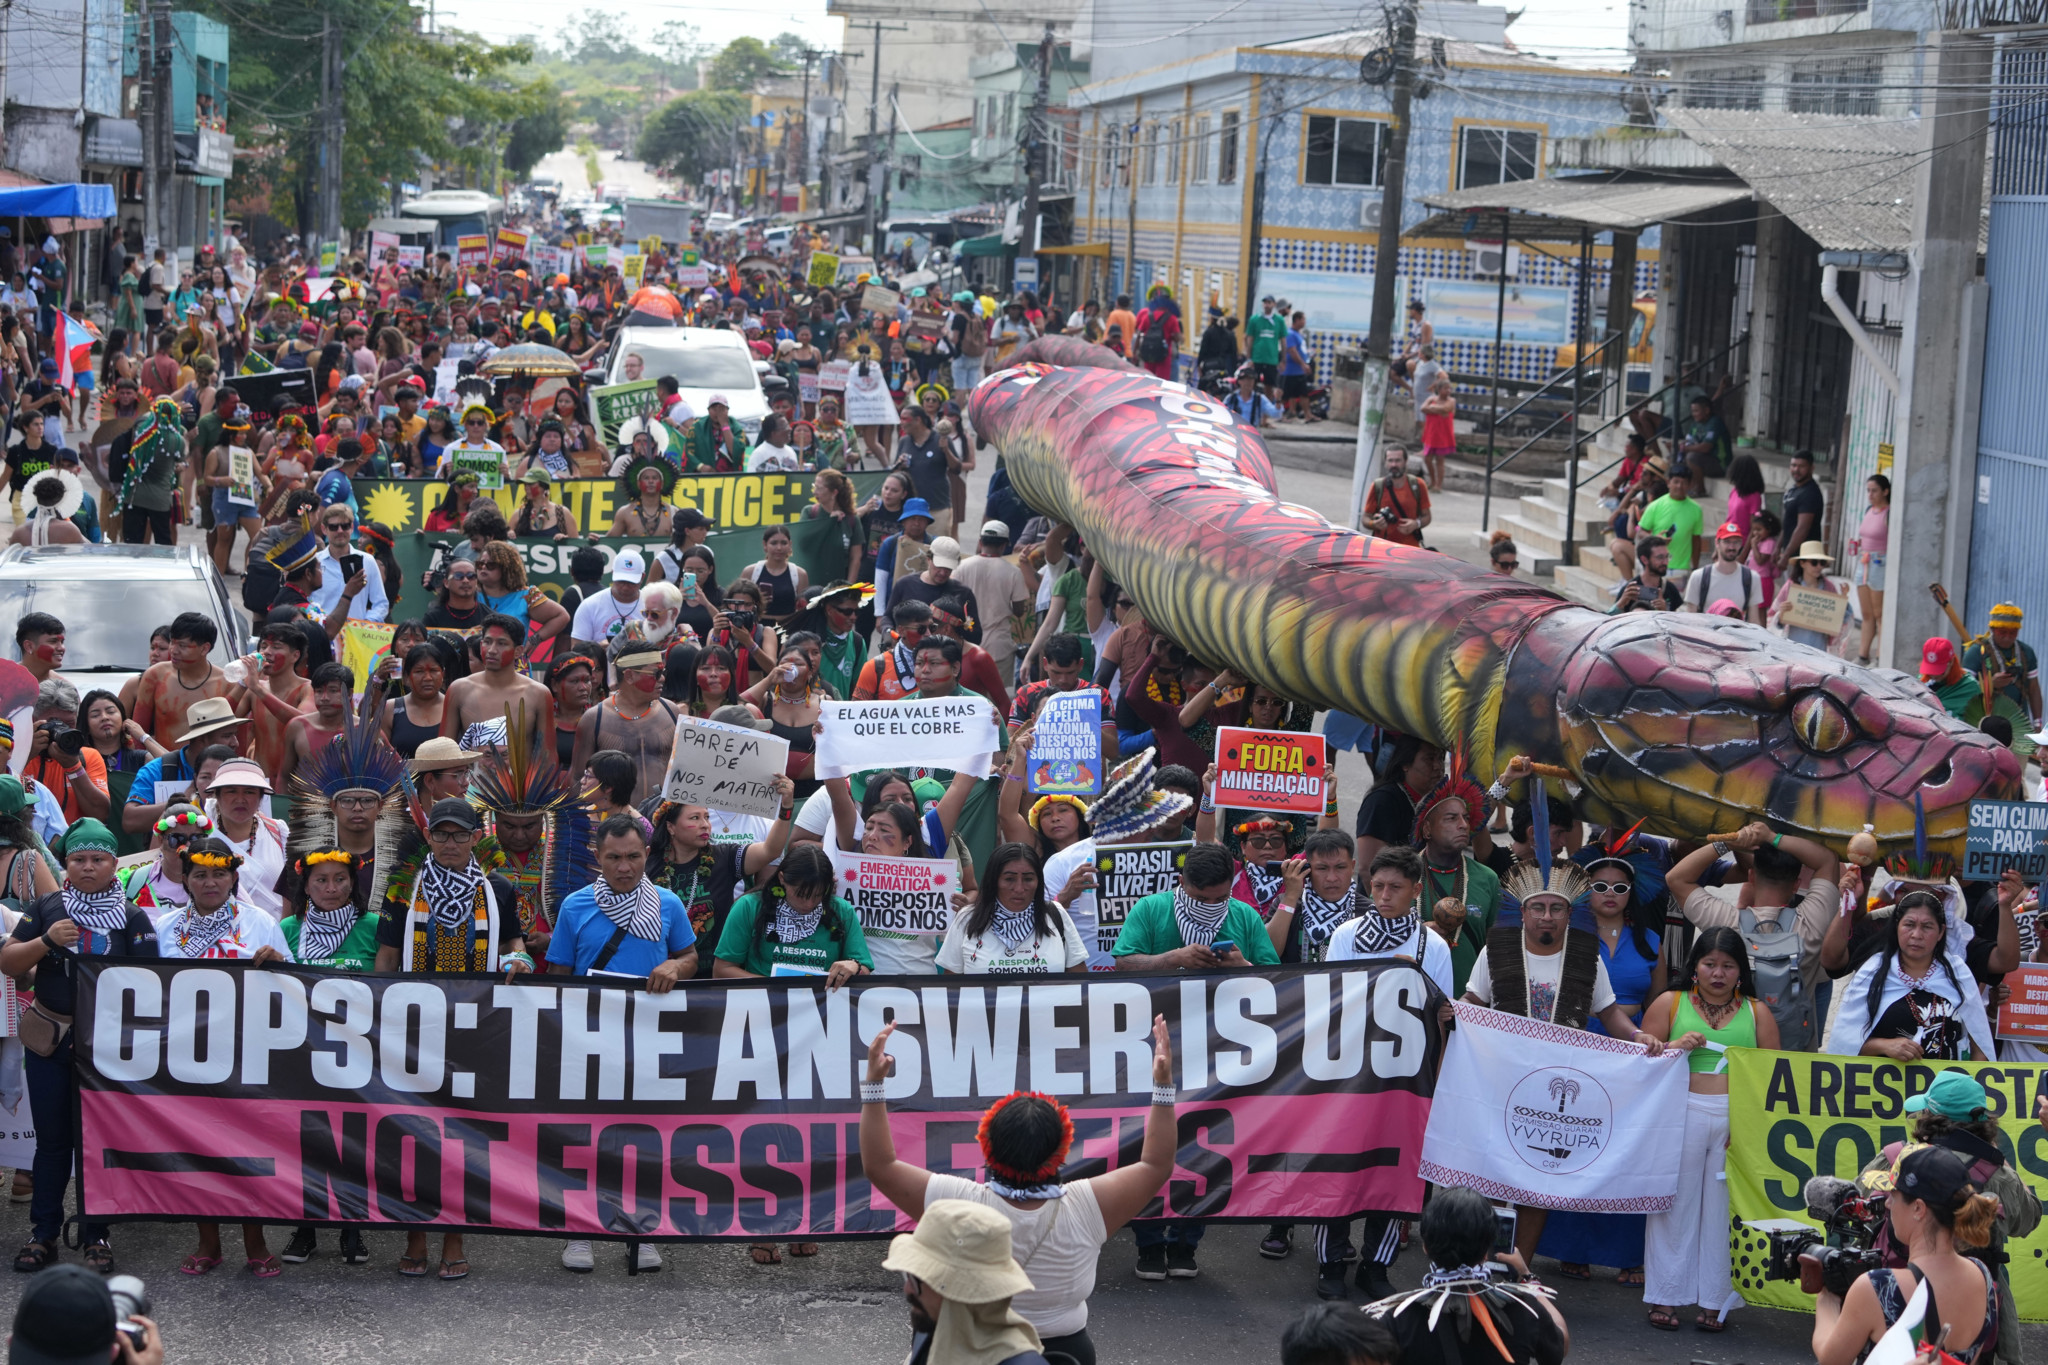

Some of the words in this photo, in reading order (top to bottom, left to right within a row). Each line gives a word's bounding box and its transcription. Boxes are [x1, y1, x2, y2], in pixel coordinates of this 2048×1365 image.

[838, 709, 855, 720] EL
[861, 707, 900, 719] AGUA
[903, 706, 942, 719] VALE
[946, 704, 976, 716] MAS
[1060, 698, 1095, 710] CLIMA
[1054, 710, 1081, 722] PELA
[854, 723, 886, 736] QUE
[890, 722, 908, 735] EL
[912, 721, 964, 735] COBRE.
[684, 729, 759, 756] PAREM
[1039, 734, 1097, 747] RESPOSTA
[714, 755, 740, 769] DE
[1030, 747, 1071, 760] SOMOS
[1239, 742, 1304, 774] FORA
[671, 769, 705, 785] NOS
[1220, 770, 1320, 797] MINERAÇÃO
[670, 788, 697, 803] SOS
[1970, 804, 2008, 829] SEM
[2009, 806, 2048, 830] CLIMA
[1991, 829, 2033, 853] PARA
[860, 861, 932, 878] EMERGÊNCIA
[1114, 850, 1175, 875] BRASIL
[1968, 850, 2047, 876] PETRÓLEO
[859, 874, 931, 891] CLIMÁTICA
[1105, 874, 1155, 898] LIVRE
[1156, 871, 1181, 894] DE
[843, 888, 855, 906] A
[858, 891, 948, 911] RESPOSTA
[853, 906, 906, 928] OMOS
[909, 908, 948, 931] NÓS
[772, 954, 806, 964] SOMOS
[773, 945, 780, 954] A
[782, 946, 827, 958] RESPOSTA
[311, 958, 363, 967] RESPSTA
[988, 959, 996, 967] A
[92, 966, 478, 1099] COP30:
[493, 984, 687, 1101] THE
[712, 981, 1155, 1101] ANSWER
[1180, 975, 1278, 1091] IS
[1302, 966, 1428, 1082] US
[1765, 1057, 1800, 1115] A
[1511, 1122, 1600, 1149] YVYRUPA
[1563, 1124, 1602, 1135] GUARANI
[300, 1110, 509, 1224] NOT
[1542, 1160, 1562, 1169] CGY
